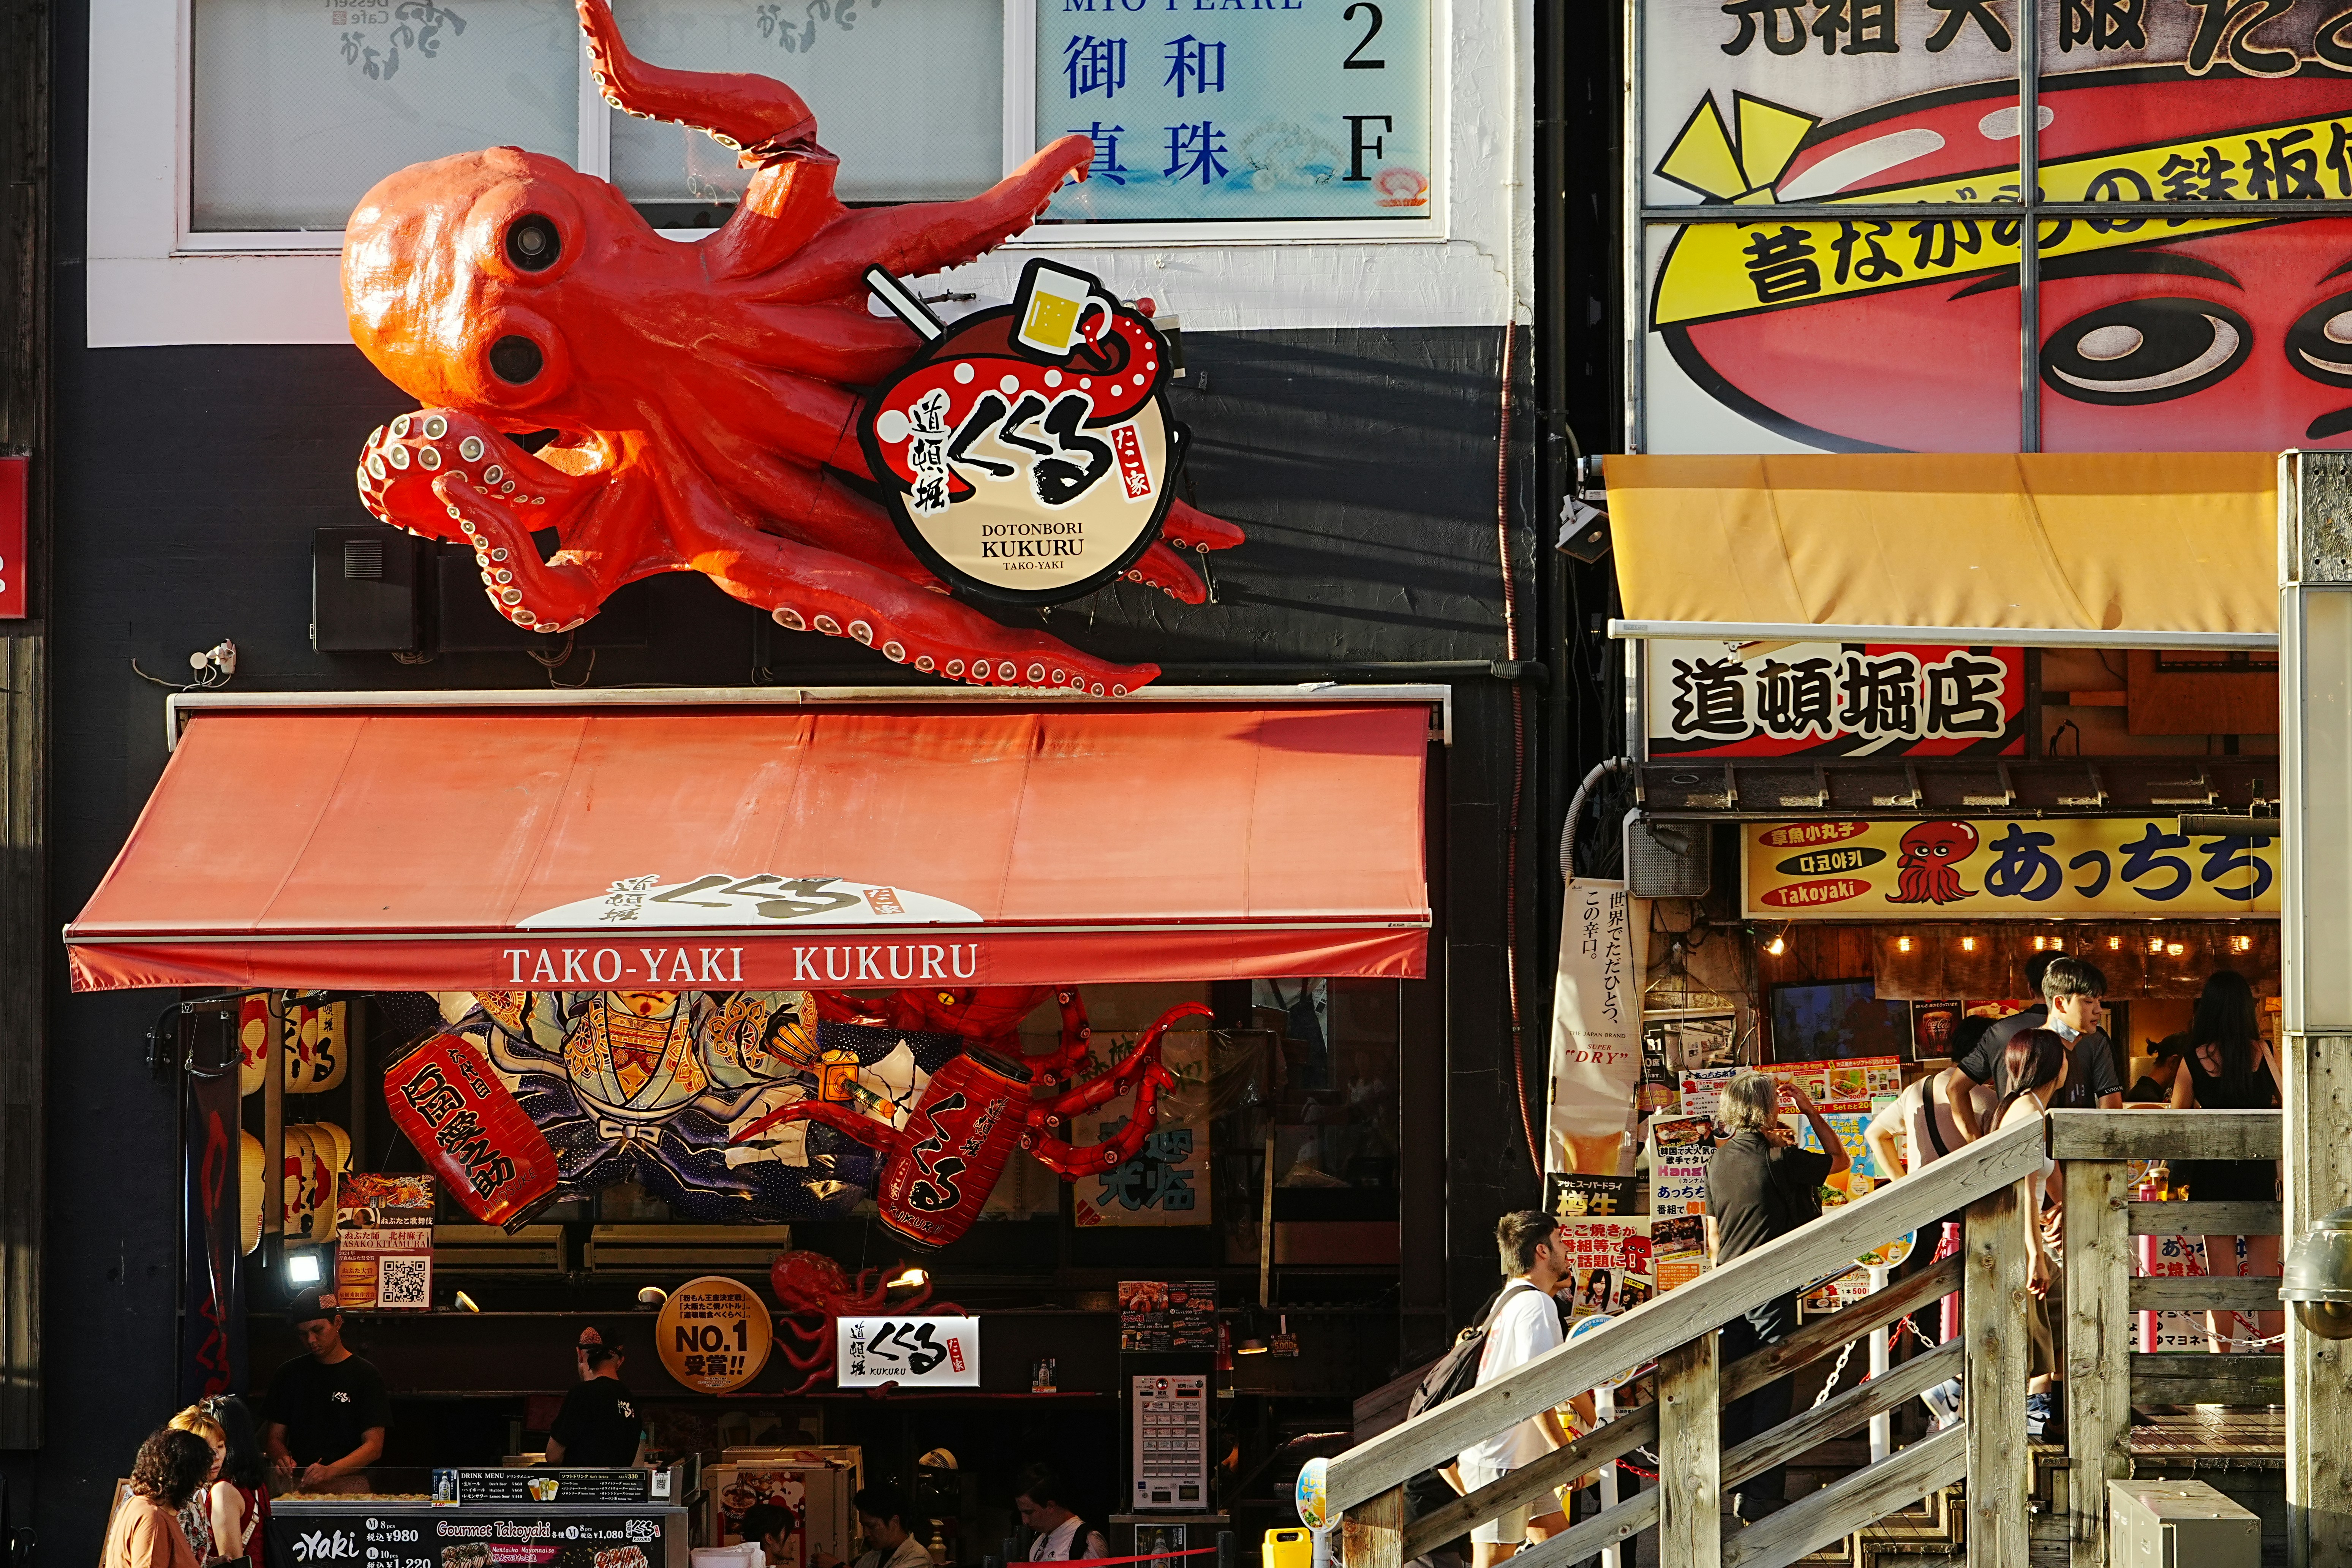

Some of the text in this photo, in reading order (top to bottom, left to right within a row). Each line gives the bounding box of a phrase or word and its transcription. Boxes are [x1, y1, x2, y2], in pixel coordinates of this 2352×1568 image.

[912, 392, 945, 512] 道頓堀
[947, 395, 1113, 505] くくる
[1117, 429, 1149, 496] たこ家
[982, 523, 1083, 536] DOTONBORI
[982, 539, 1084, 558] KUKURU
[1003, 561, 1064, 571] TAKO-YAKI
[1674, 655, 2001, 734] 道頓堀店
[1772, 822, 1854, 845] 章魚小丸子
[1800, 850, 1862, 873] 다코야키
[1778, 881, 1854, 904] Takoyaki
[1582, 892, 1600, 959] この辛口。
[504, 944, 978, 983] TAKO-YAKI KUKURU
[1602, 892, 1625, 1024] 世界でただひとつ、
[909, 1092, 966, 1212] くくる
[484, 1168, 537, 1217] AINOSUKE
[1557, 1180, 1622, 1190] アサヒスーパードライ
[888, 1202, 944, 1233] KUKURU
[389, 1231, 425, 1240] 北村麻子
[1559, 1224, 1636, 1237] たこ焼きが
[676, 1320, 747, 1352] NO.1
[850, 1321, 964, 1377] 道頓堀 くくる たこ家
[367, 1519, 377, 1529] M
[437, 1521, 493, 1538] Gourmet
[493, 1521, 551, 1543] Takoyaki
[567, 1527, 578, 1538] M
[594, 1530, 623, 1539] ¥1,080
[367, 1530, 418, 1542] 税込 ¥980
[368, 1548, 377, 1559] L
[493, 1554, 536, 1562] 明太マヨたこ焼
